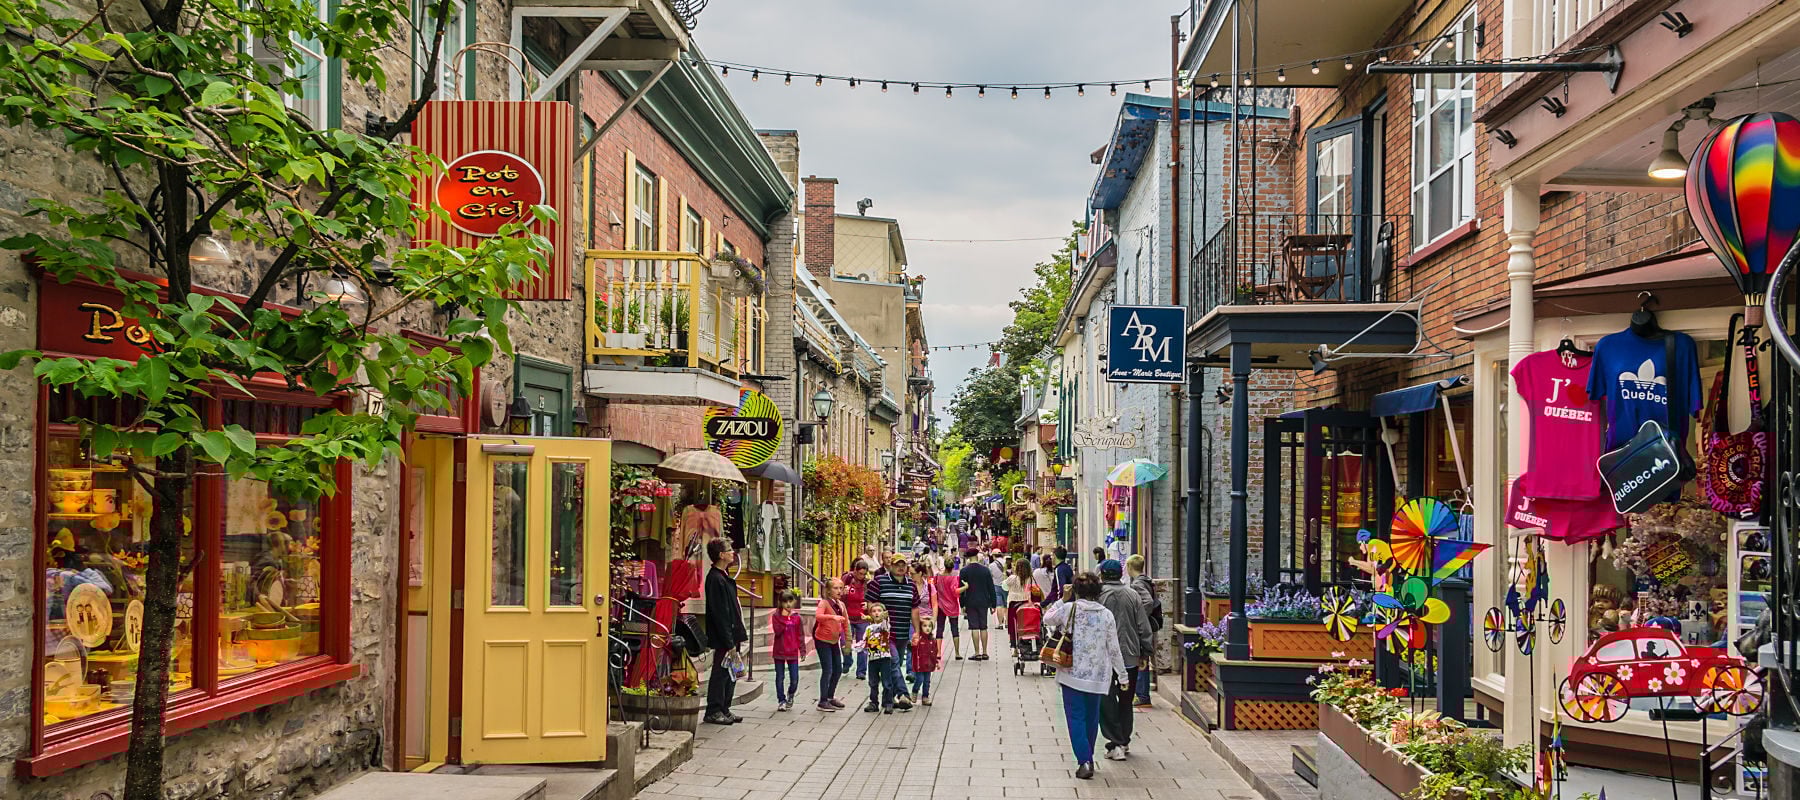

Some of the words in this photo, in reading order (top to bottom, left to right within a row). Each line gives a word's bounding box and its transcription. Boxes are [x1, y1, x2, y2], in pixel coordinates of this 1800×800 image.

[457, 164, 520, 182] Pot
[470, 185, 515, 197] en
[458, 200, 524, 219] Ciel
[1120, 310, 1174, 363] ABM
[1154, 368, 1182, 380] Boutique
[1621, 388, 1668, 405] Quebec
[1543, 406, 1593, 422] QUÉBEC
[715, 420, 768, 437] ZAZOU
[1073, 433, 1131, 449] Scrupules
[1614, 470, 1651, 502] québec
[1514, 513, 1548, 528] QUÉBEC
